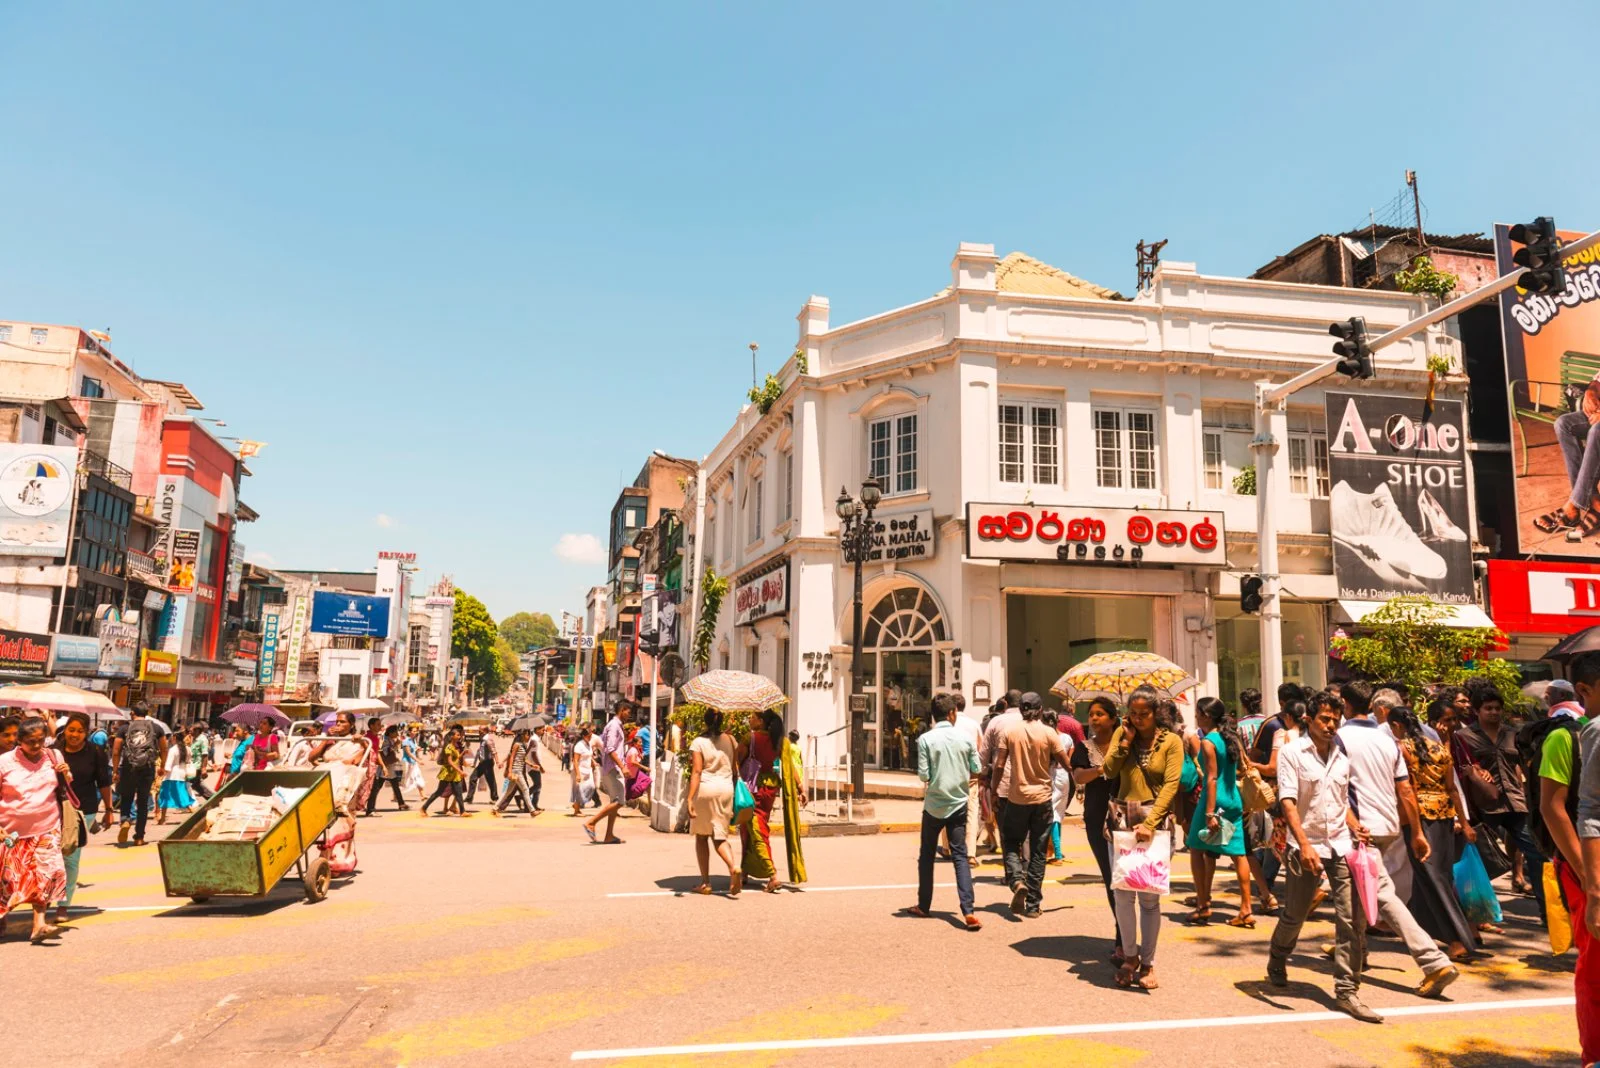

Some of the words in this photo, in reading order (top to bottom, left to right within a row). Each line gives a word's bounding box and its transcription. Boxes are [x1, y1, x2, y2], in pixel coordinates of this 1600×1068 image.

[1330, 398, 1460, 454] A-One
[1387, 463, 1464, 488] SHOE
[889, 530, 931, 545] MAHAL
[1127, 516, 1218, 549] මහල්
